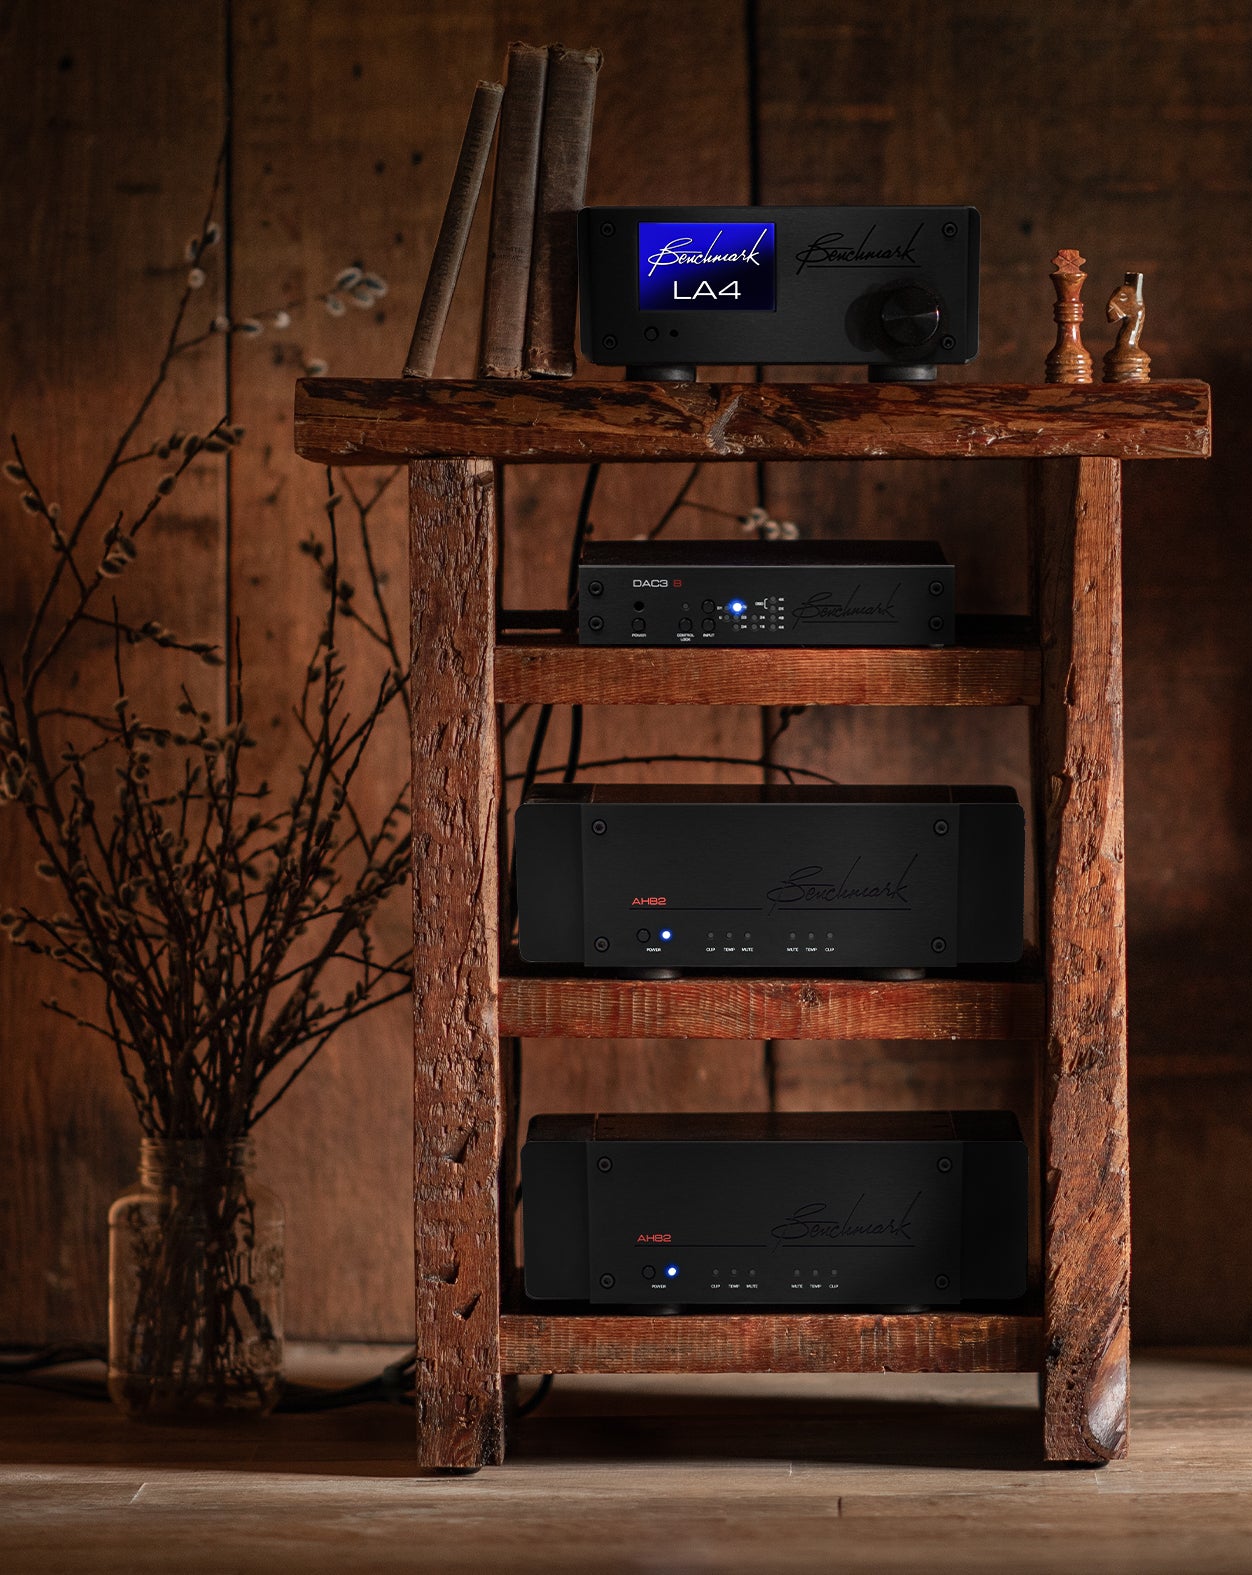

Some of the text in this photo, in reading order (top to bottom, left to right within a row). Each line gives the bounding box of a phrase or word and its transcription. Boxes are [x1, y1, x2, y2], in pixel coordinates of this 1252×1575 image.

[647, 228, 768, 277] Benchmark
[796, 222, 925, 275] Benchmark
[673, 280, 742, 300] LA4
[632, 579, 669, 588] DAC3
[792, 582, 901, 630] Benchmark
[766, 853, 918, 916] Benchmark
[770, 1191, 922, 1255] Benchmark
